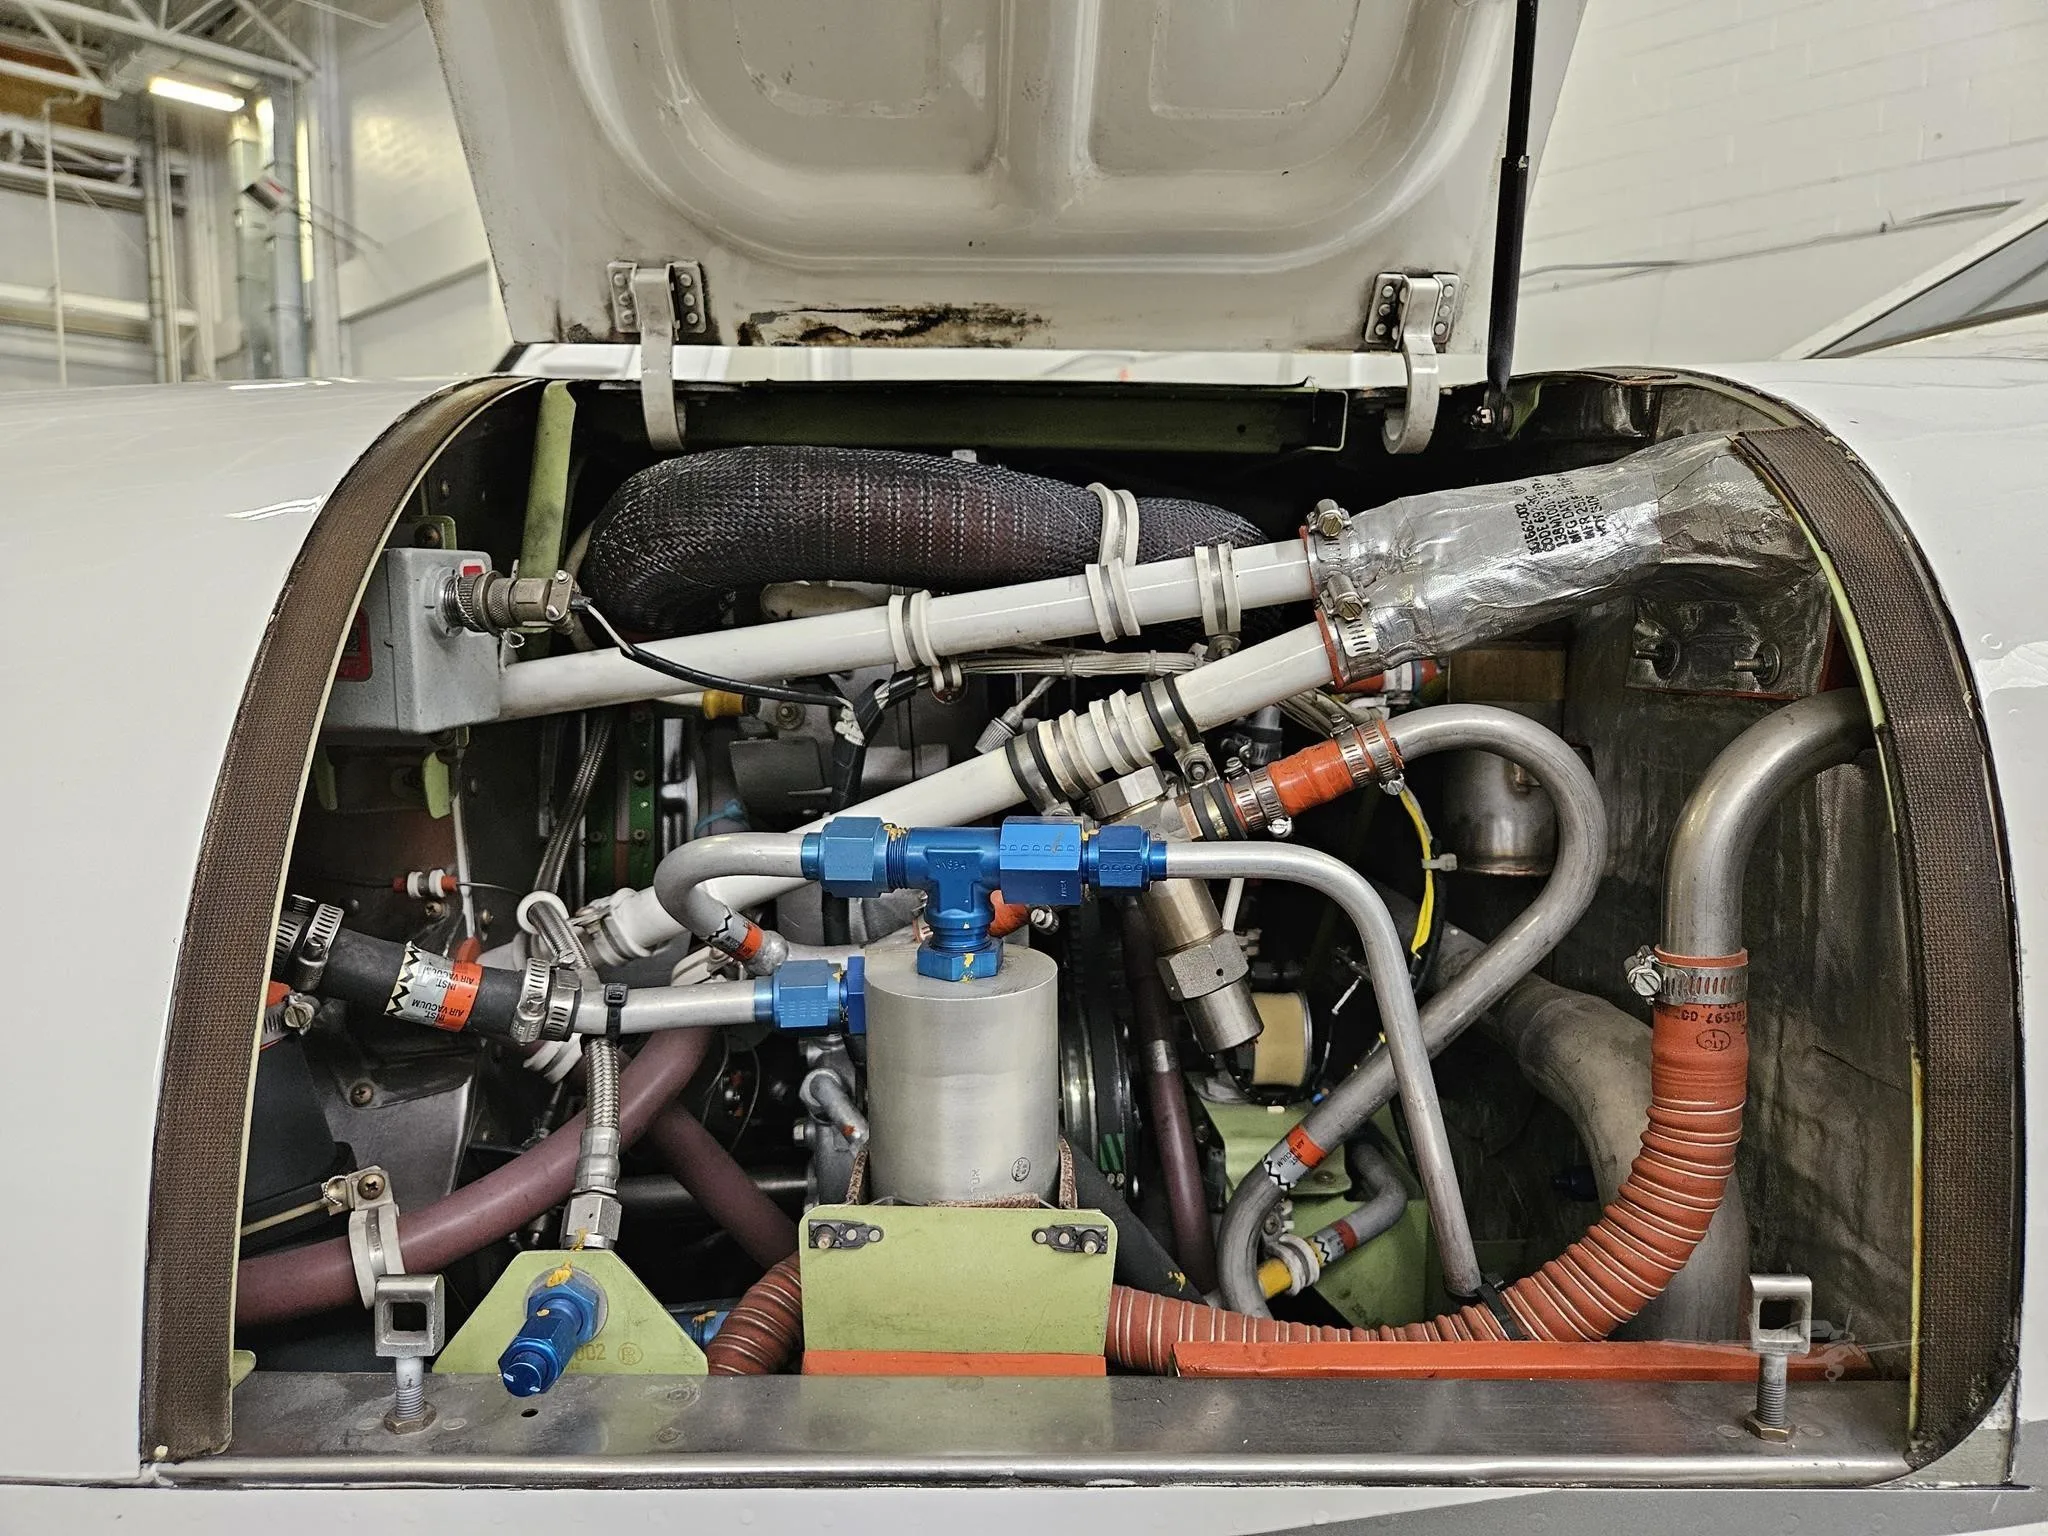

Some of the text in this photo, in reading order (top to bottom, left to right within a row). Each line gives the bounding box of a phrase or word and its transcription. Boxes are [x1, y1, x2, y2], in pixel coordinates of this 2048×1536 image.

[460, 975, 475, 985] AIR
[411, 999, 465, 1017] AIR VACUUM
